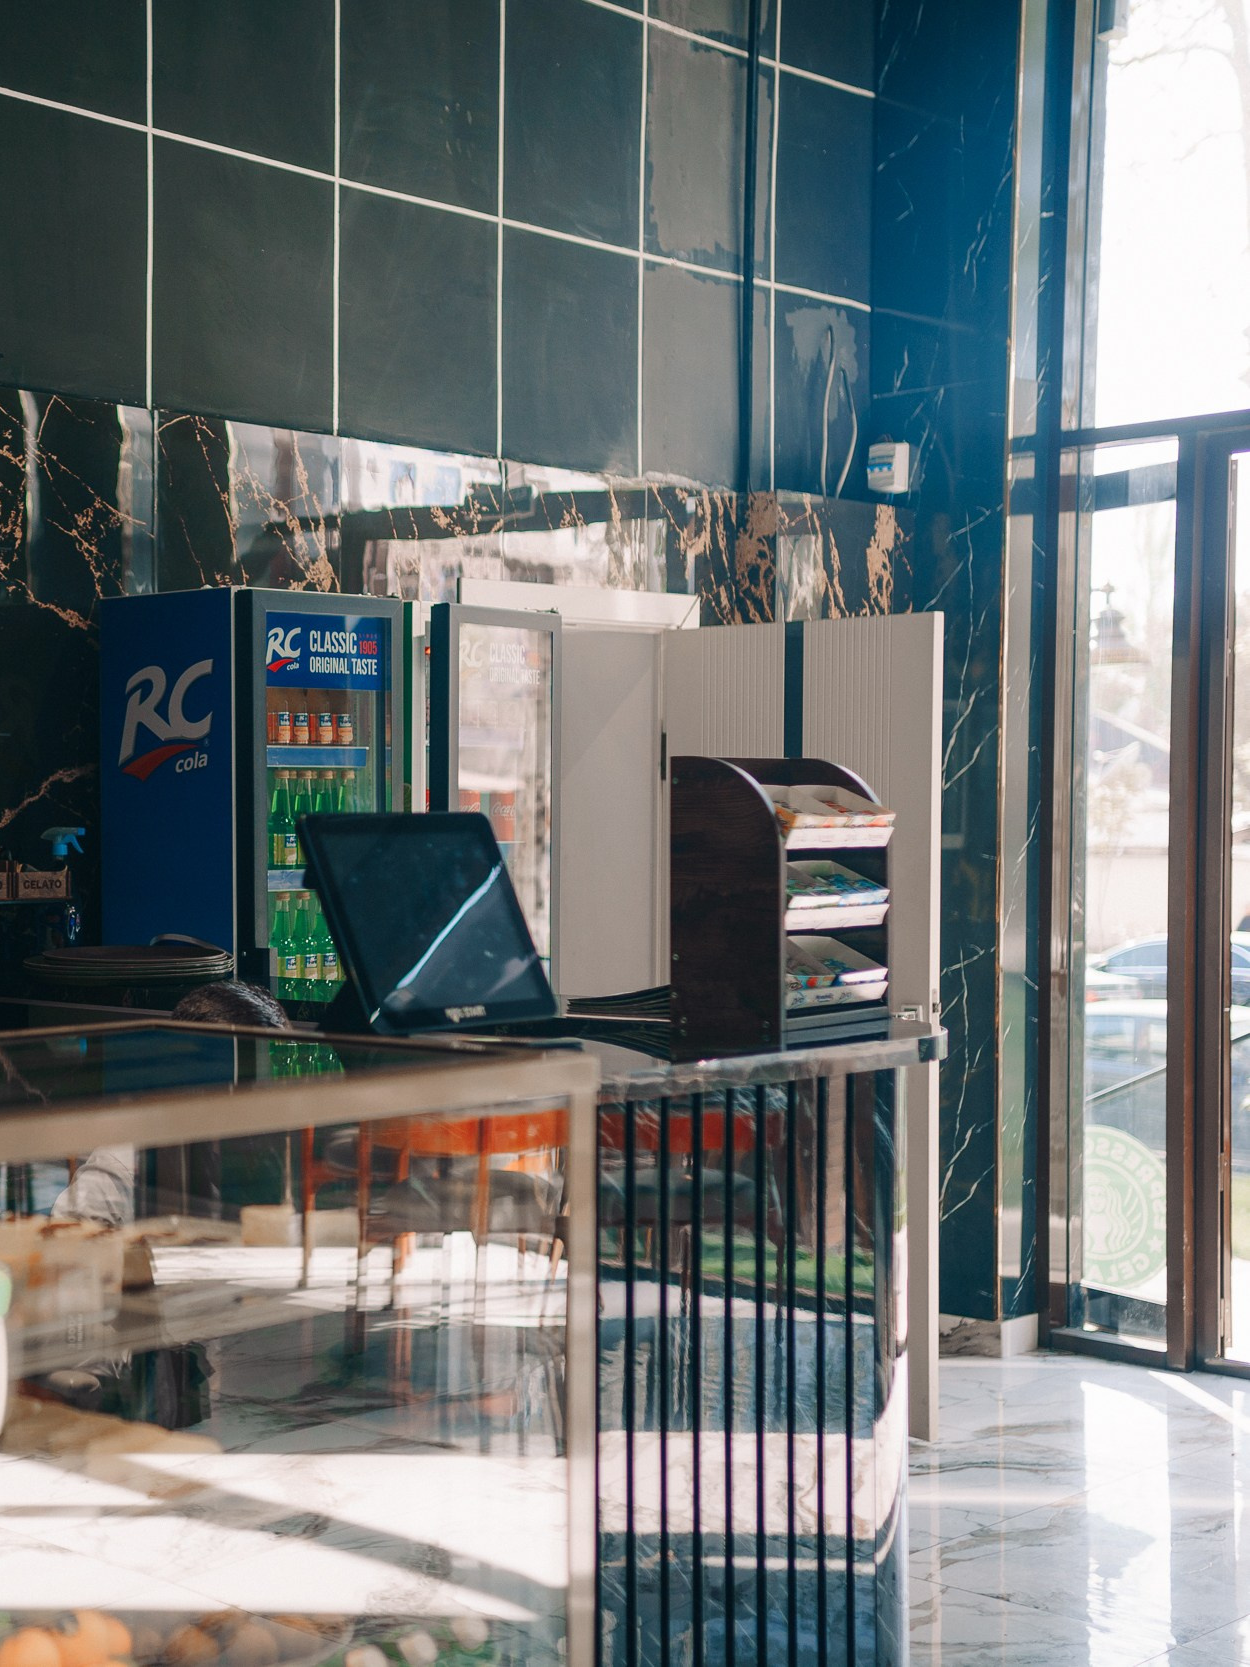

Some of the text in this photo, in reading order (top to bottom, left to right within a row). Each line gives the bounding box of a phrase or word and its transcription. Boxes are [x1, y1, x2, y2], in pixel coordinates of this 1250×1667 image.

[265, 627, 302, 665] RC
[309, 630, 358, 655] CLASSIC
[358, 640, 378, 655] 1905
[489, 642, 526, 665] CLASSIC
[286, 661, 300, 671] cola
[309, 656, 378, 676] ORIGINAL TASTE
[489, 666, 541, 685] ORIGINAL TASTE
[118, 658, 214, 767] RC
[175, 751, 208, 773] cola
[23, 879, 62, 890] GELATO
